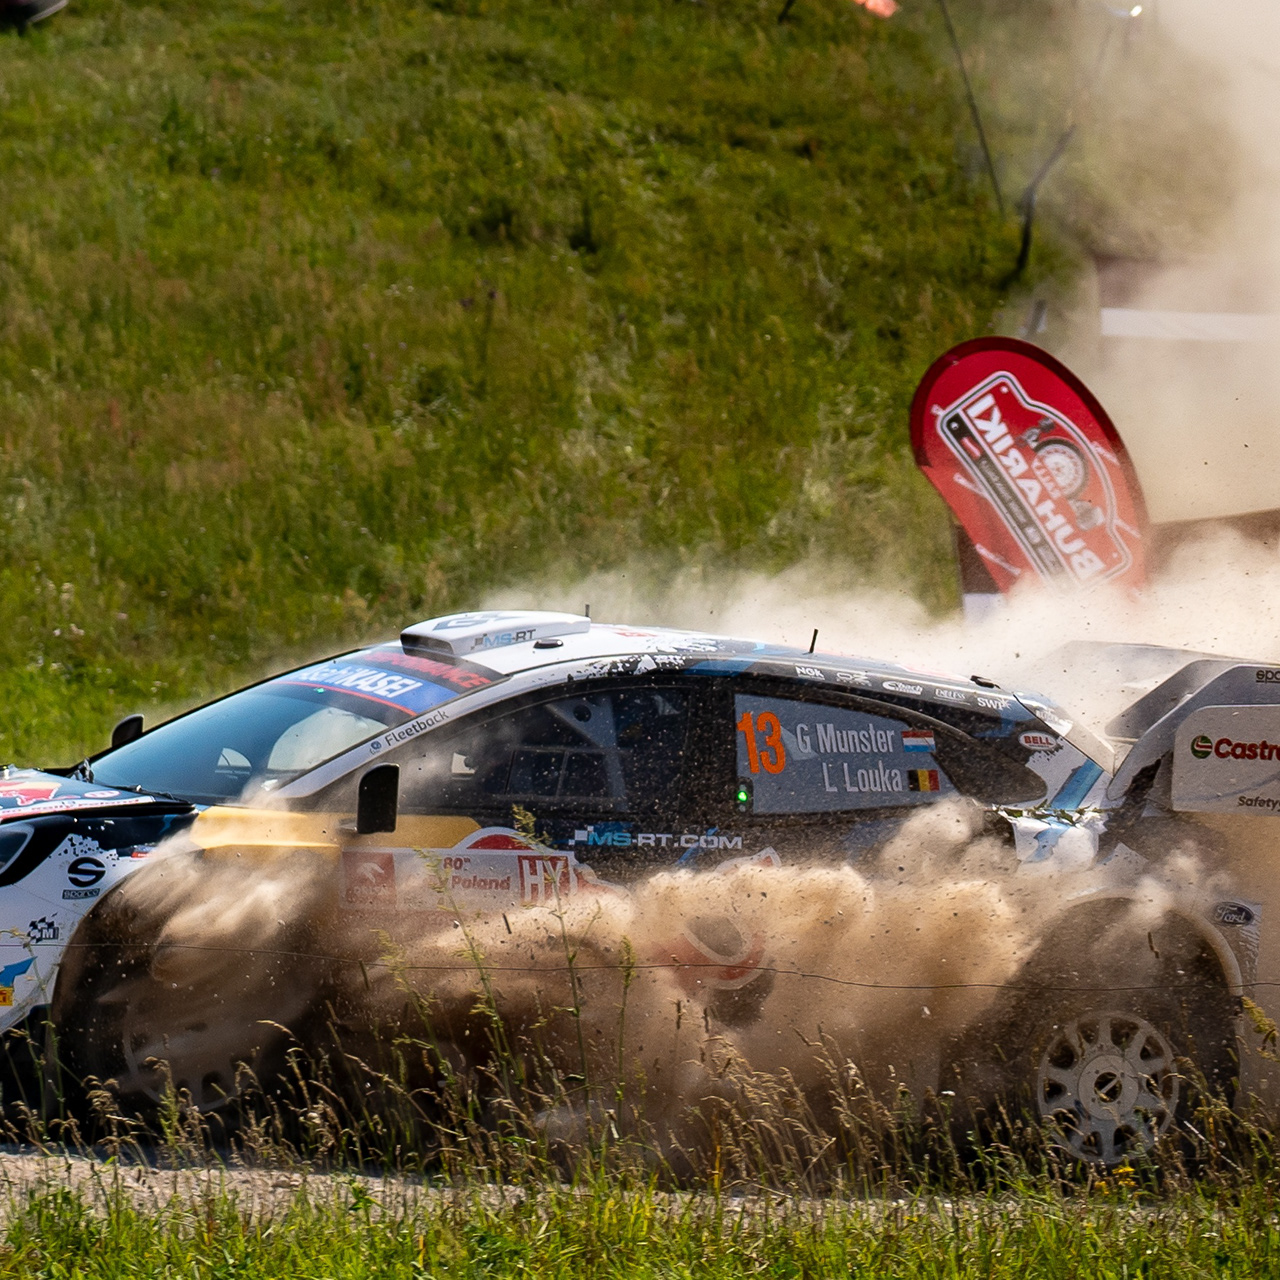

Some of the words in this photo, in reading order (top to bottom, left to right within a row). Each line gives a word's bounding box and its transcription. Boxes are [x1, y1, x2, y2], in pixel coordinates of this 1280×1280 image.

[484, 628, 536, 648] MS-RT
[795, 666, 824, 678] NGK
[385, 710, 449, 746] Fleetback
[736, 711, 787, 775] 13
[796, 723, 812, 754] G
[819, 723, 895, 754] Munster
[1023, 735, 1053, 746] BELL
[823, 762, 838, 792] L
[844, 761, 903, 792] Louka
[587, 829, 743, 850] MS-RT.COM
[451, 874, 512, 891] Poland
[1216, 906, 1248, 923] Ford
